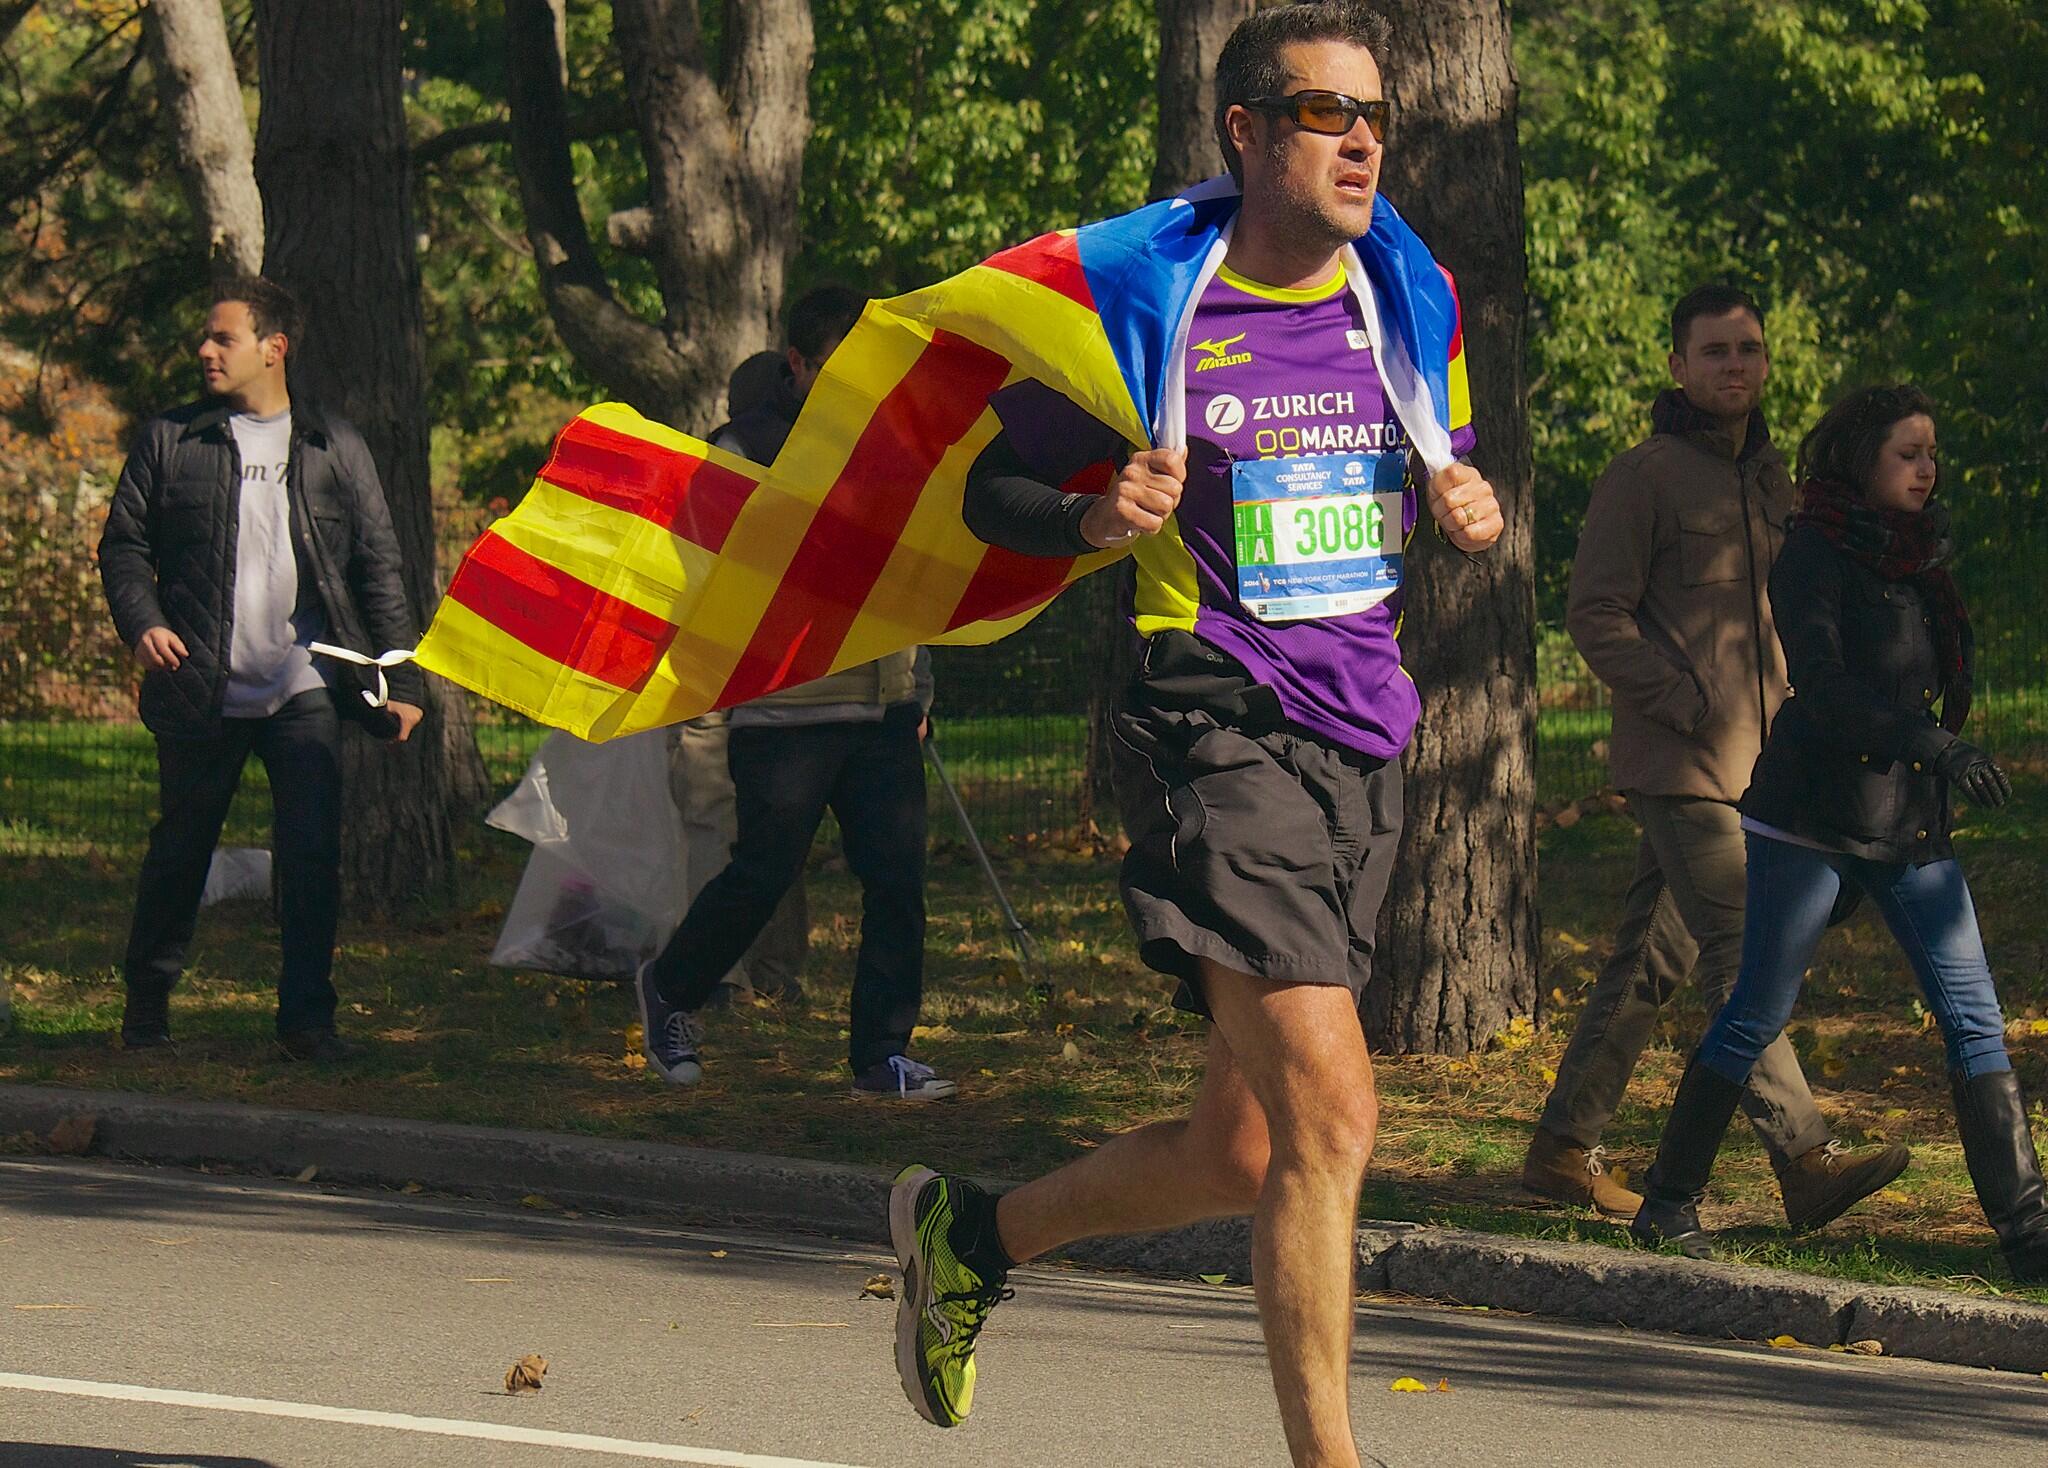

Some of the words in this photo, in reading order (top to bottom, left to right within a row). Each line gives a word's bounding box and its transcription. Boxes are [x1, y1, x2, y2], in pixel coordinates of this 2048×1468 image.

[1195, 352, 1252, 372] MIZUNO
[1251, 392, 1355, 420] ZURICH
[1301, 419, 1397, 450] MARATÓ
[1276, 471, 1331, 484] CONSULTANCY
[1292, 463, 1316, 472] TATA
[1287, 482, 1323, 493] SERVICES
[1342, 476, 1366, 486] TATA
[1294, 501, 1384, 556] 3086
[1254, 538, 1270, 562] A
